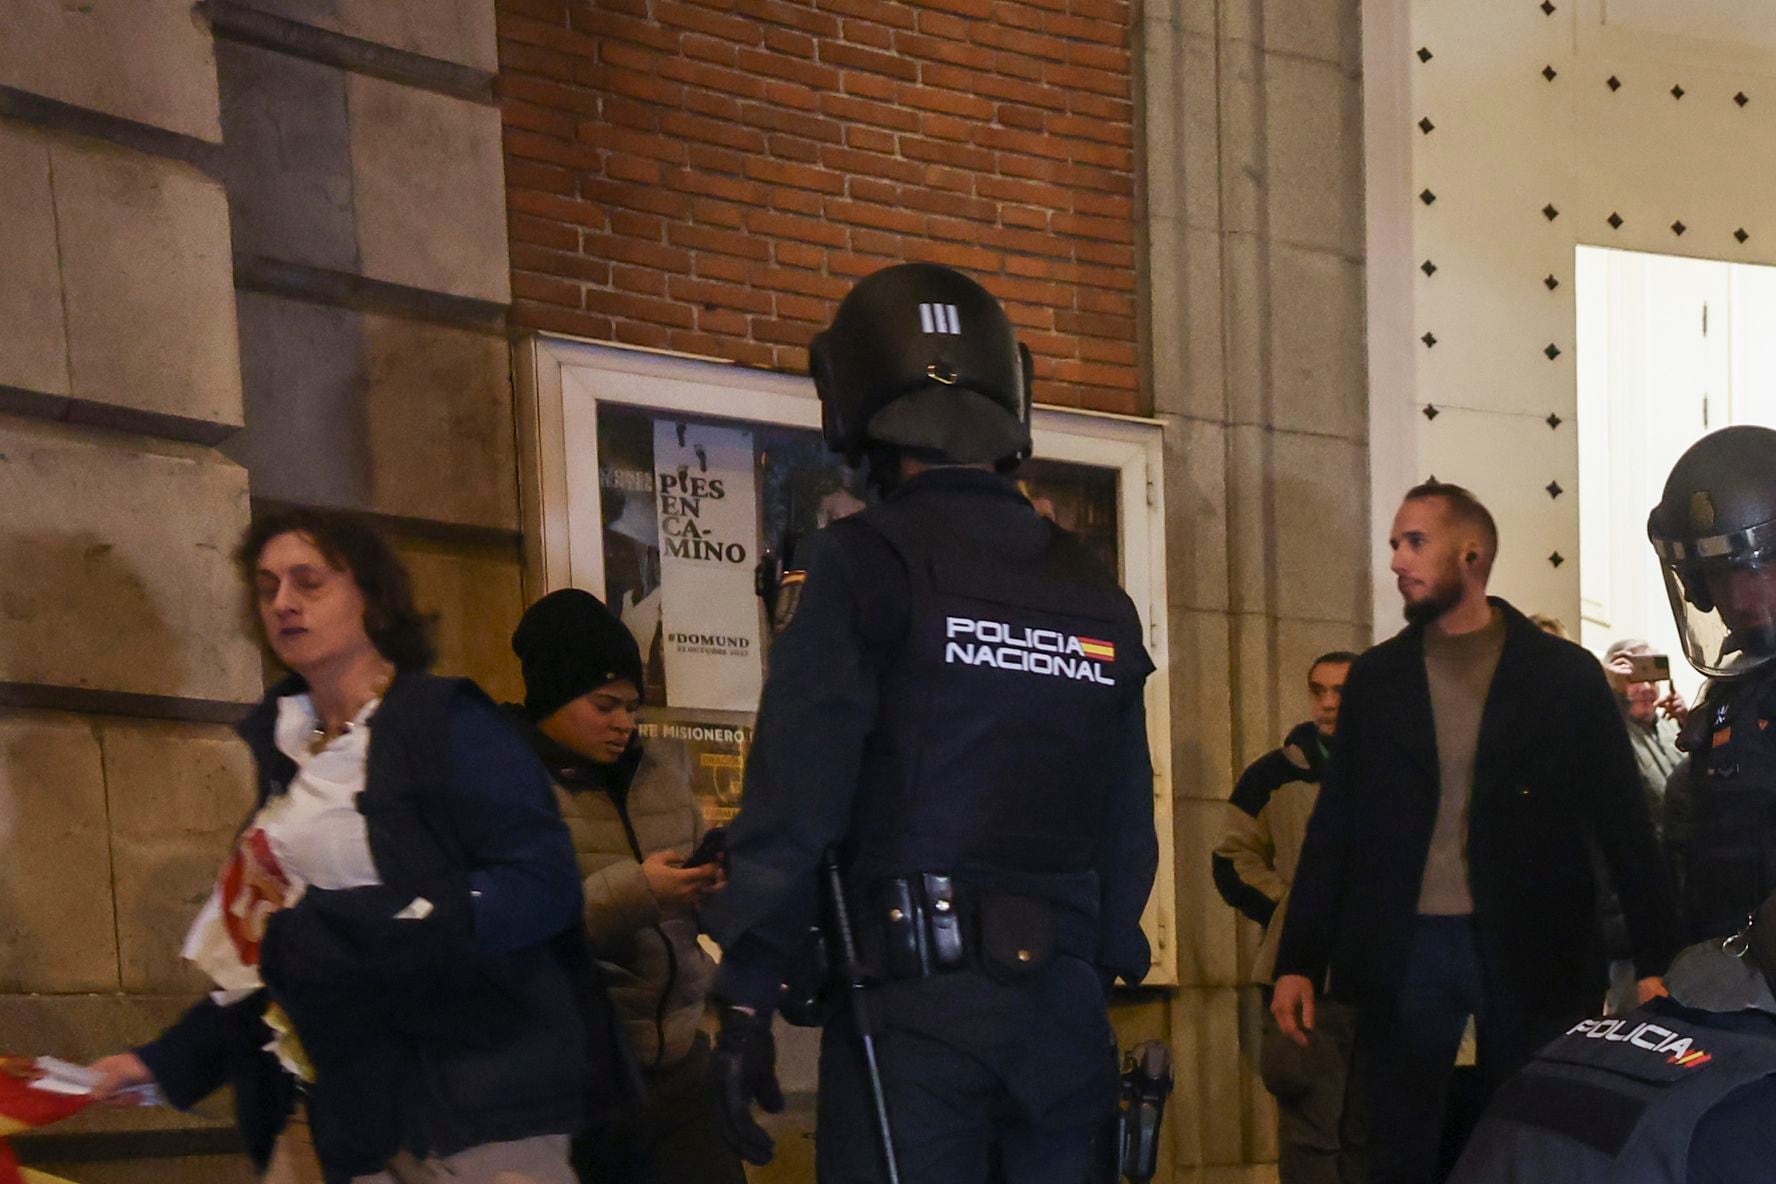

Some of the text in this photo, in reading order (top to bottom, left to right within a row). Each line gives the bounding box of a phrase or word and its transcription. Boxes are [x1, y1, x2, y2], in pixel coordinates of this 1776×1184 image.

[660, 466, 725, 499] PIES
[661, 495, 699, 518] EN
[661, 516, 711, 539] CA-
[663, 537, 746, 563] MINO
[668, 633, 750, 649] #DOMUND
[945, 641, 1116, 686] NACIONAL
[663, 723, 744, 742] MISIONERO
